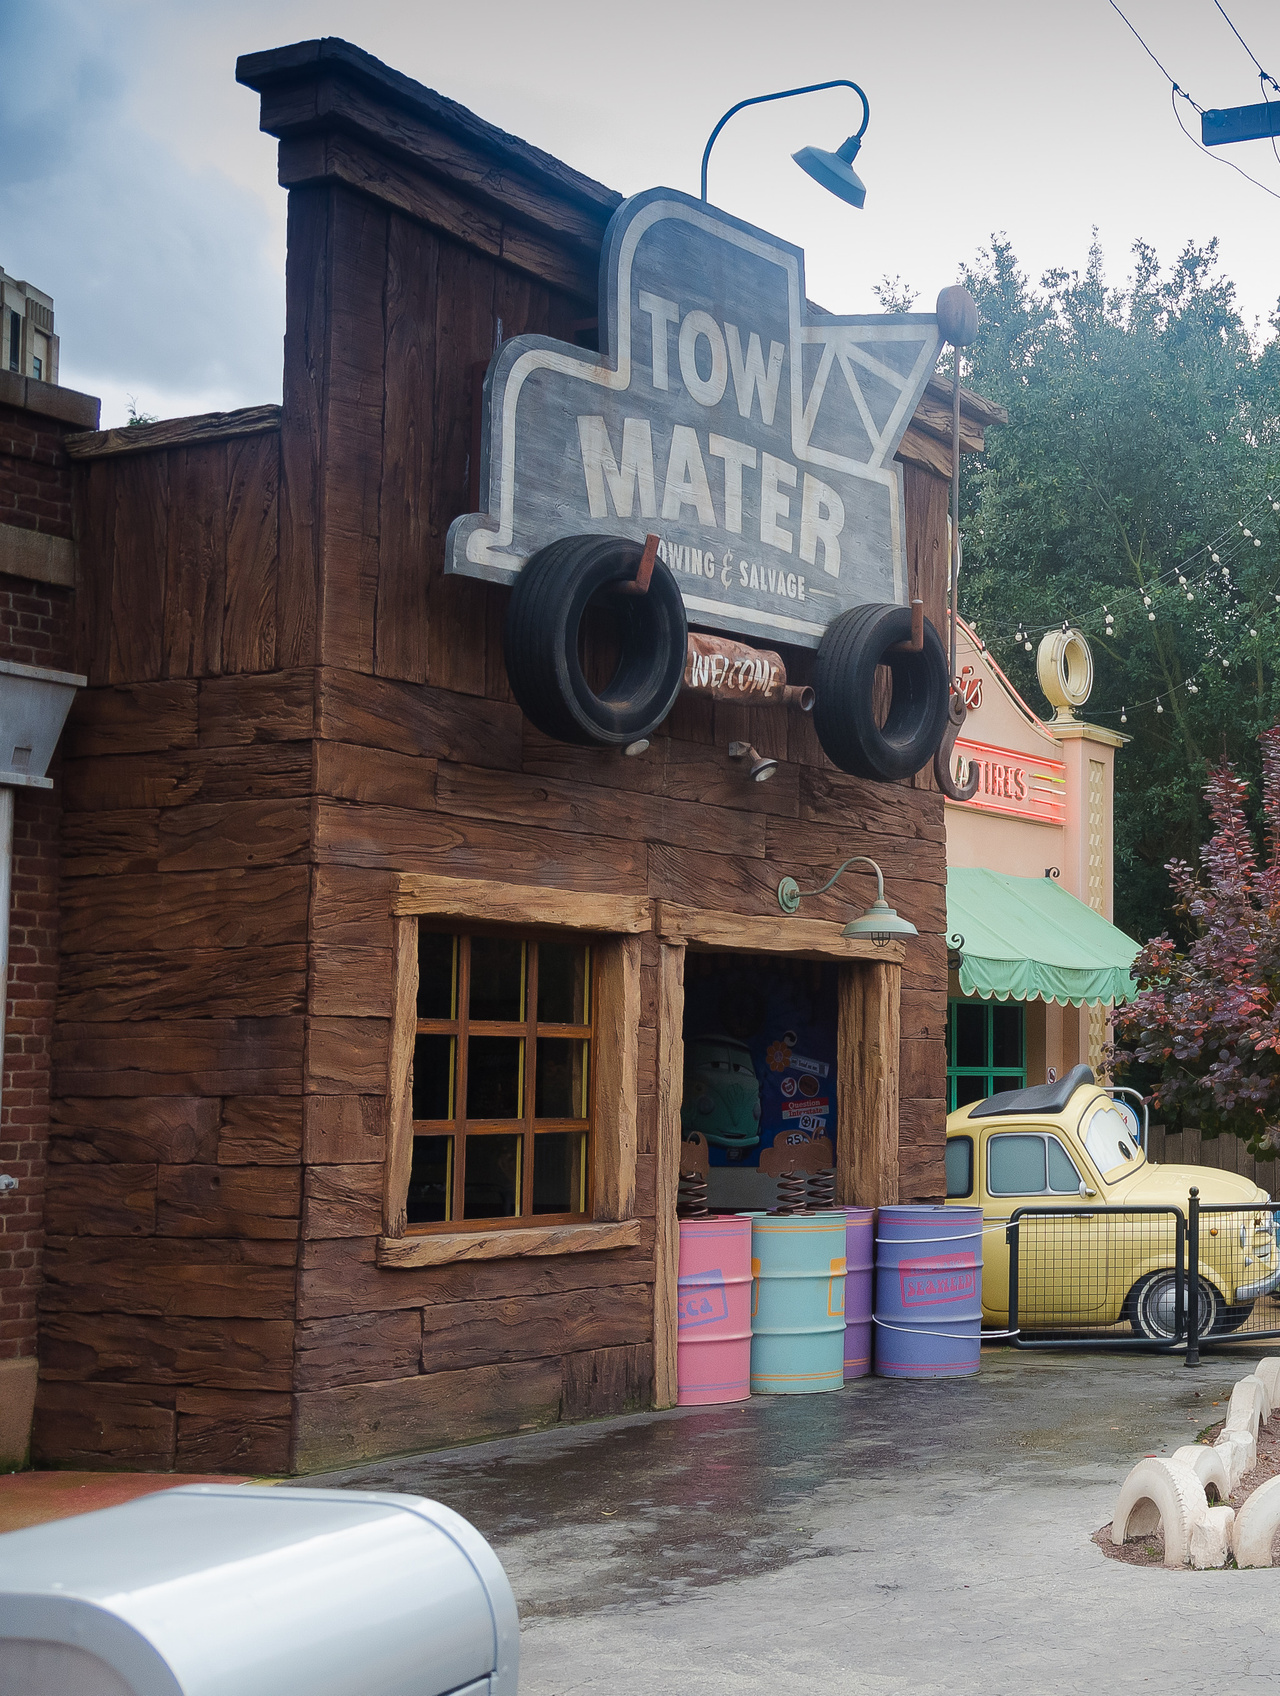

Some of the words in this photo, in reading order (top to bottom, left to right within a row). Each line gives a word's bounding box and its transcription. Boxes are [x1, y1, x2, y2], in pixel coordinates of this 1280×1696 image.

[639, 290, 785, 426] TOW
[577, 416, 845, 578] MATER
[657, 540, 715, 578] OWING
[721, 549, 733, 590] &
[739, 560, 805, 601] SALVAGE
[691, 651, 779, 697] WELCOME
[973, 758, 1028, 802] TIRES
[788, 1099, 821, 1110] Question
[907, 1274, 973, 1297] SEAWEED
